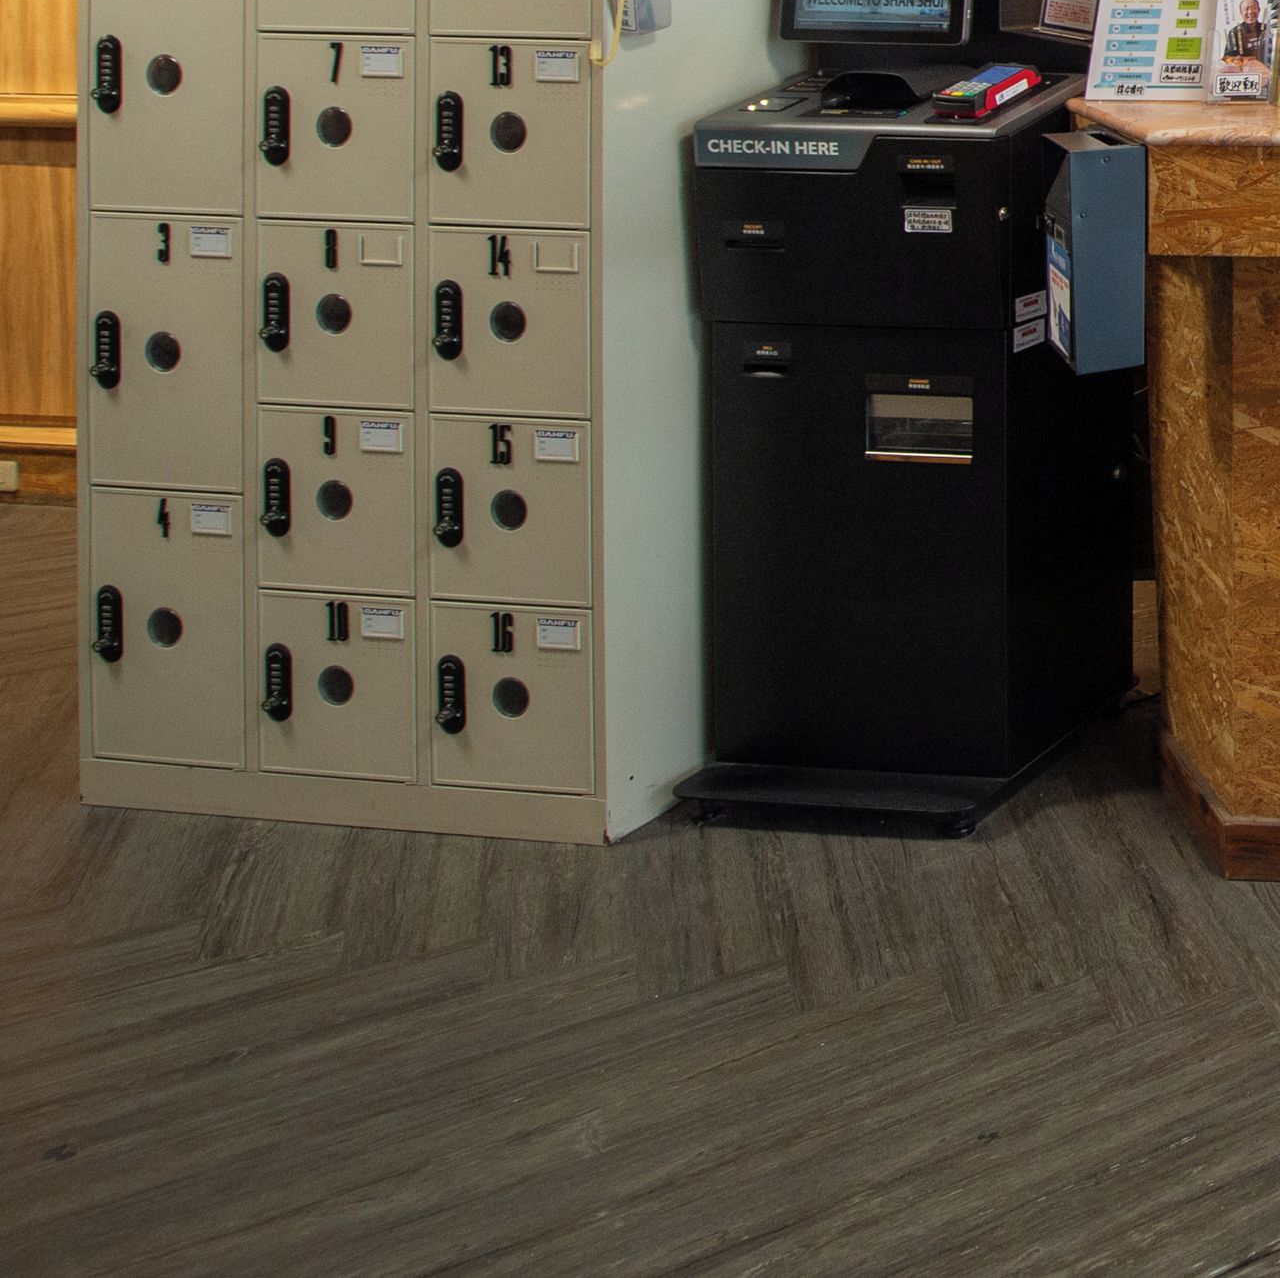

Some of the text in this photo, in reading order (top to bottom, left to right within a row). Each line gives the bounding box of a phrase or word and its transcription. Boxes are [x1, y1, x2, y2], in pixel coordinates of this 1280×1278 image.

[330, 42, 343, 83] 7
[489, 45, 512, 87] 13
[707, 139, 839, 156] CHECK-IN HERE
[157, 223, 170, 263] 3
[324, 229, 338, 269] 8
[487, 235, 511, 276] 14
[323, 416, 336, 455] 9
[489, 423, 513, 465] 15
[157, 498, 170, 538] 4
[326, 601, 349, 642] 10
[491, 612, 514, 653] 16
